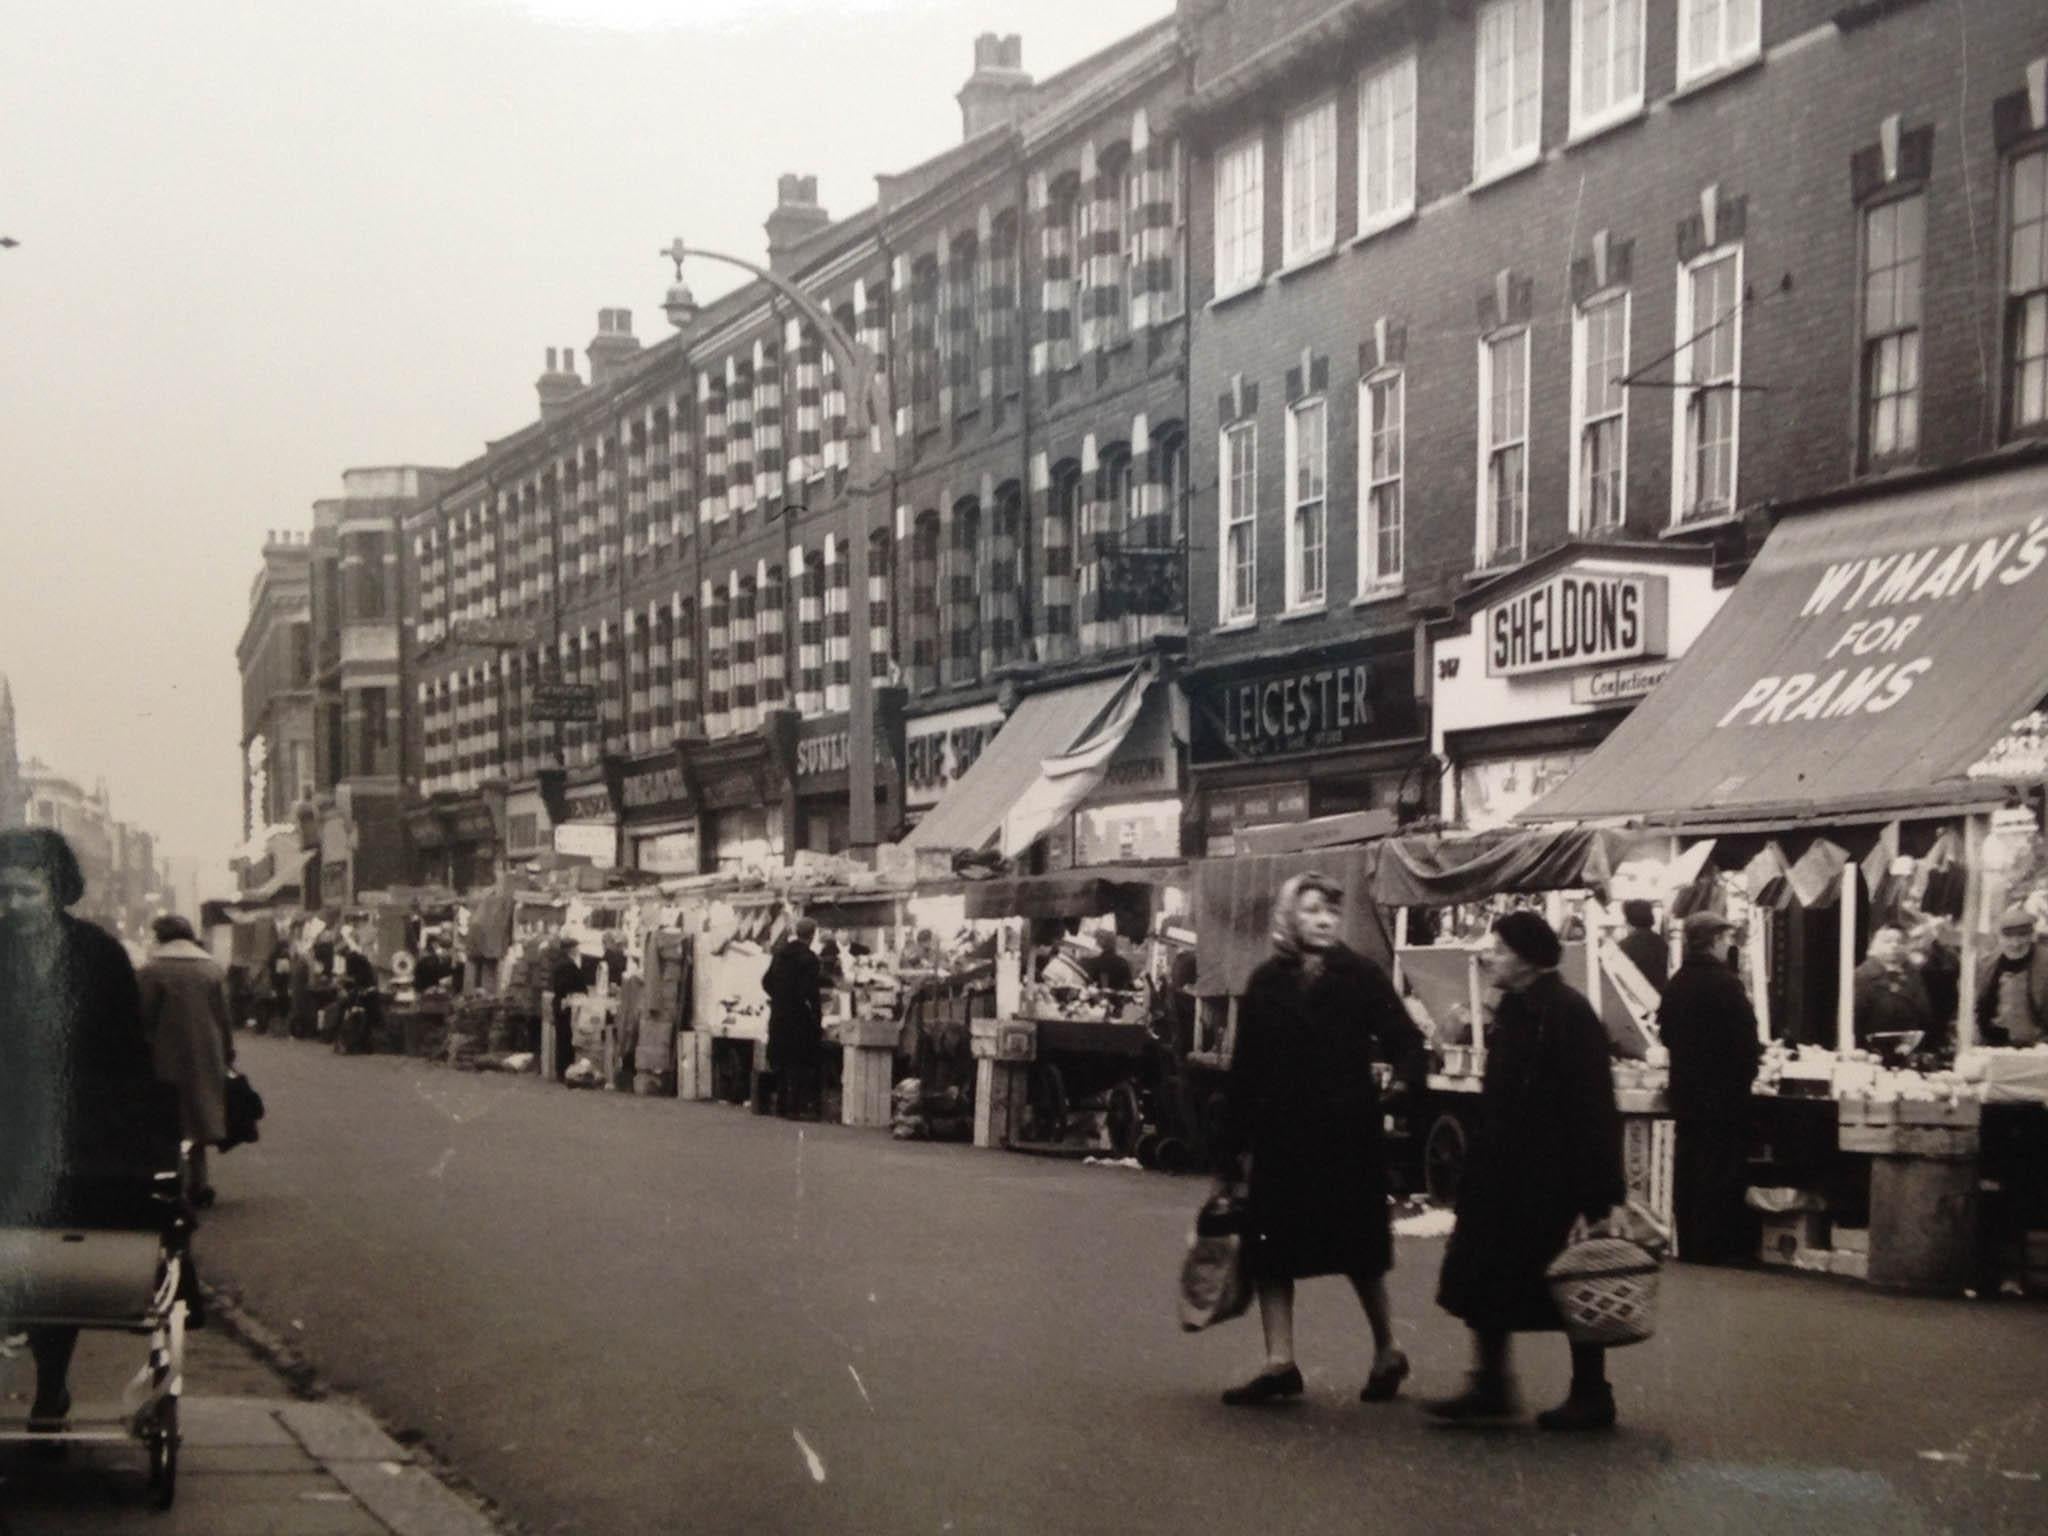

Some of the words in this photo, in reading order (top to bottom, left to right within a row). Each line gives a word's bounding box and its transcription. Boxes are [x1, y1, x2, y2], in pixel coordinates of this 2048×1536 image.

[1801, 515, 2048, 617] WYMAN'S
[1495, 578, 1637, 668] SHELDON'S
[1826, 614, 1922, 659] FOR
[1224, 665, 1367, 746] LEICESTER
[1716, 656, 1932, 728] PRAMS
